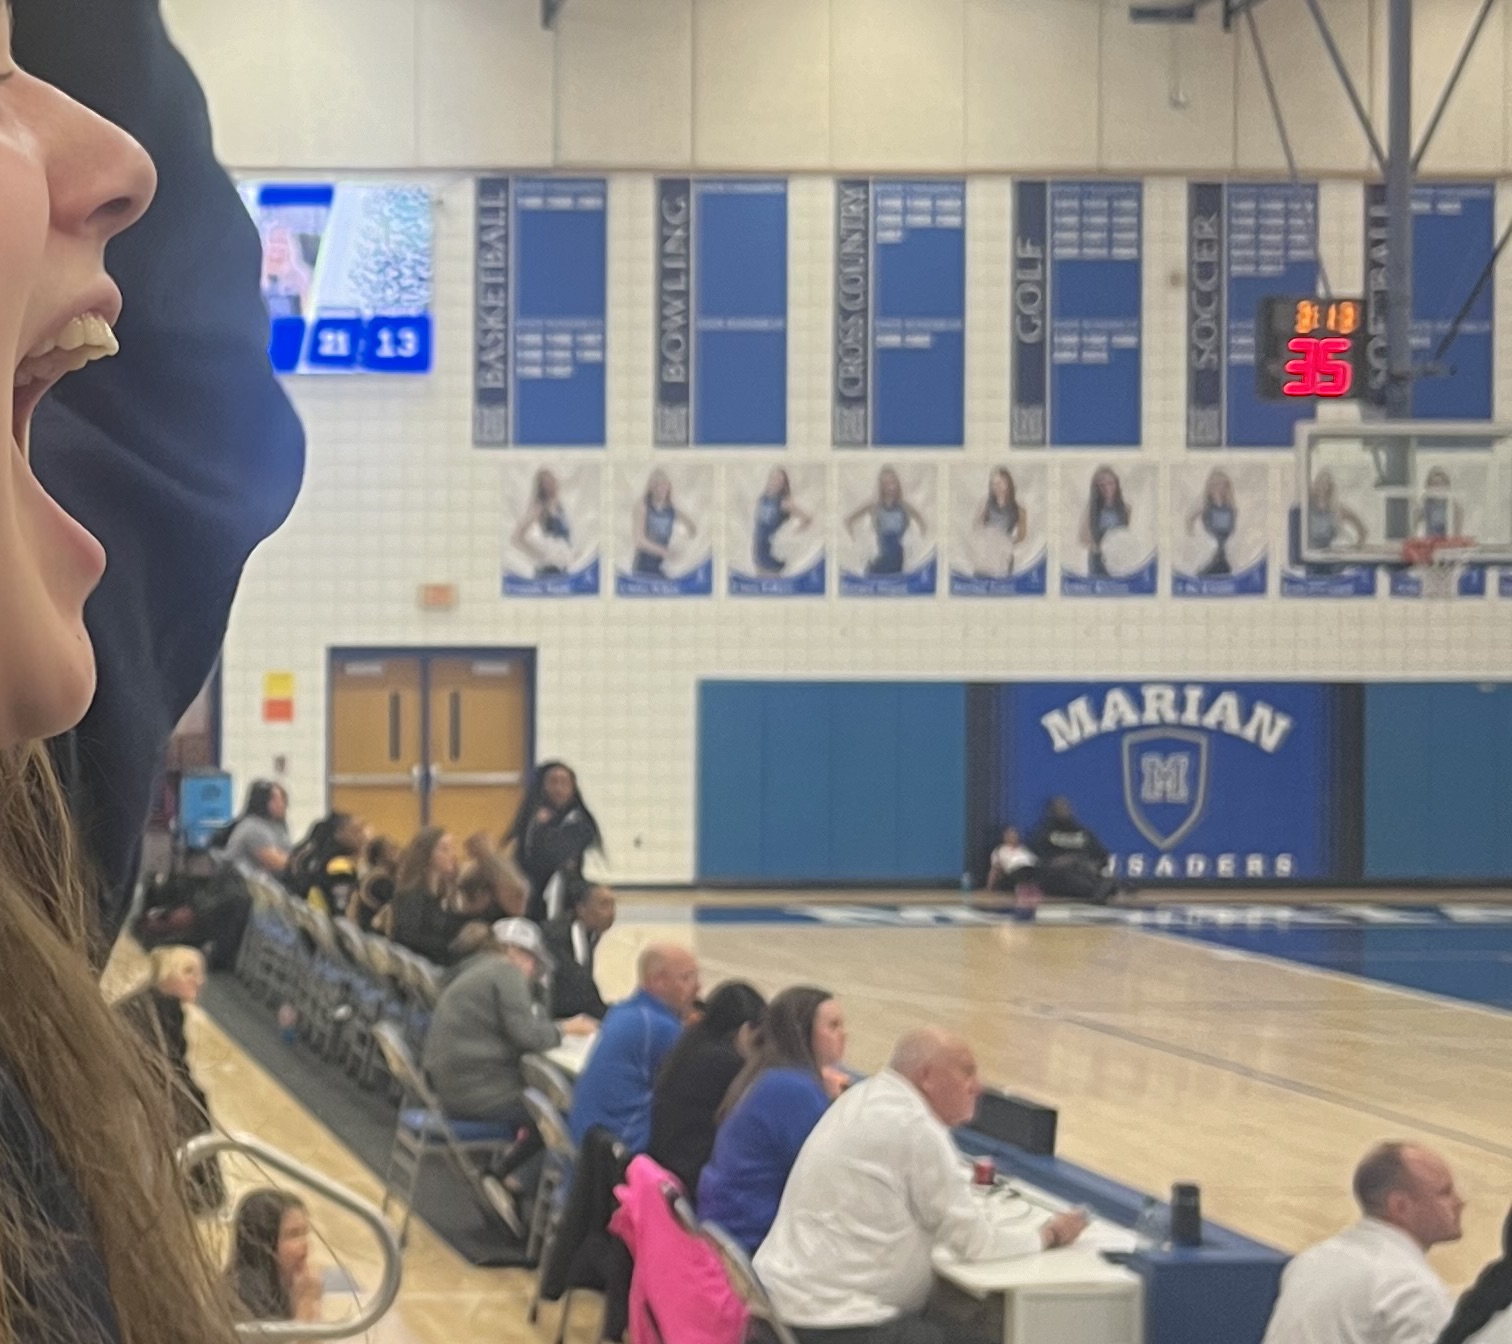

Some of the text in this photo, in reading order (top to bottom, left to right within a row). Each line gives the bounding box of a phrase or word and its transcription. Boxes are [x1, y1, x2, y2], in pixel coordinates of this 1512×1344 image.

[479, 190, 506, 389] BASKETBALL
[661, 193, 687, 383] BOWLING
[839, 185, 866, 311] COUNTRY
[1015, 236, 1043, 344] GOLF
[1192, 213, 1218, 370] SOCCER
[375, 326, 420, 359] 13
[1282, 337, 1352, 397] 35
[1041, 684, 1293, 753] MARIAN
[1101, 853, 1294, 878] SADERS
